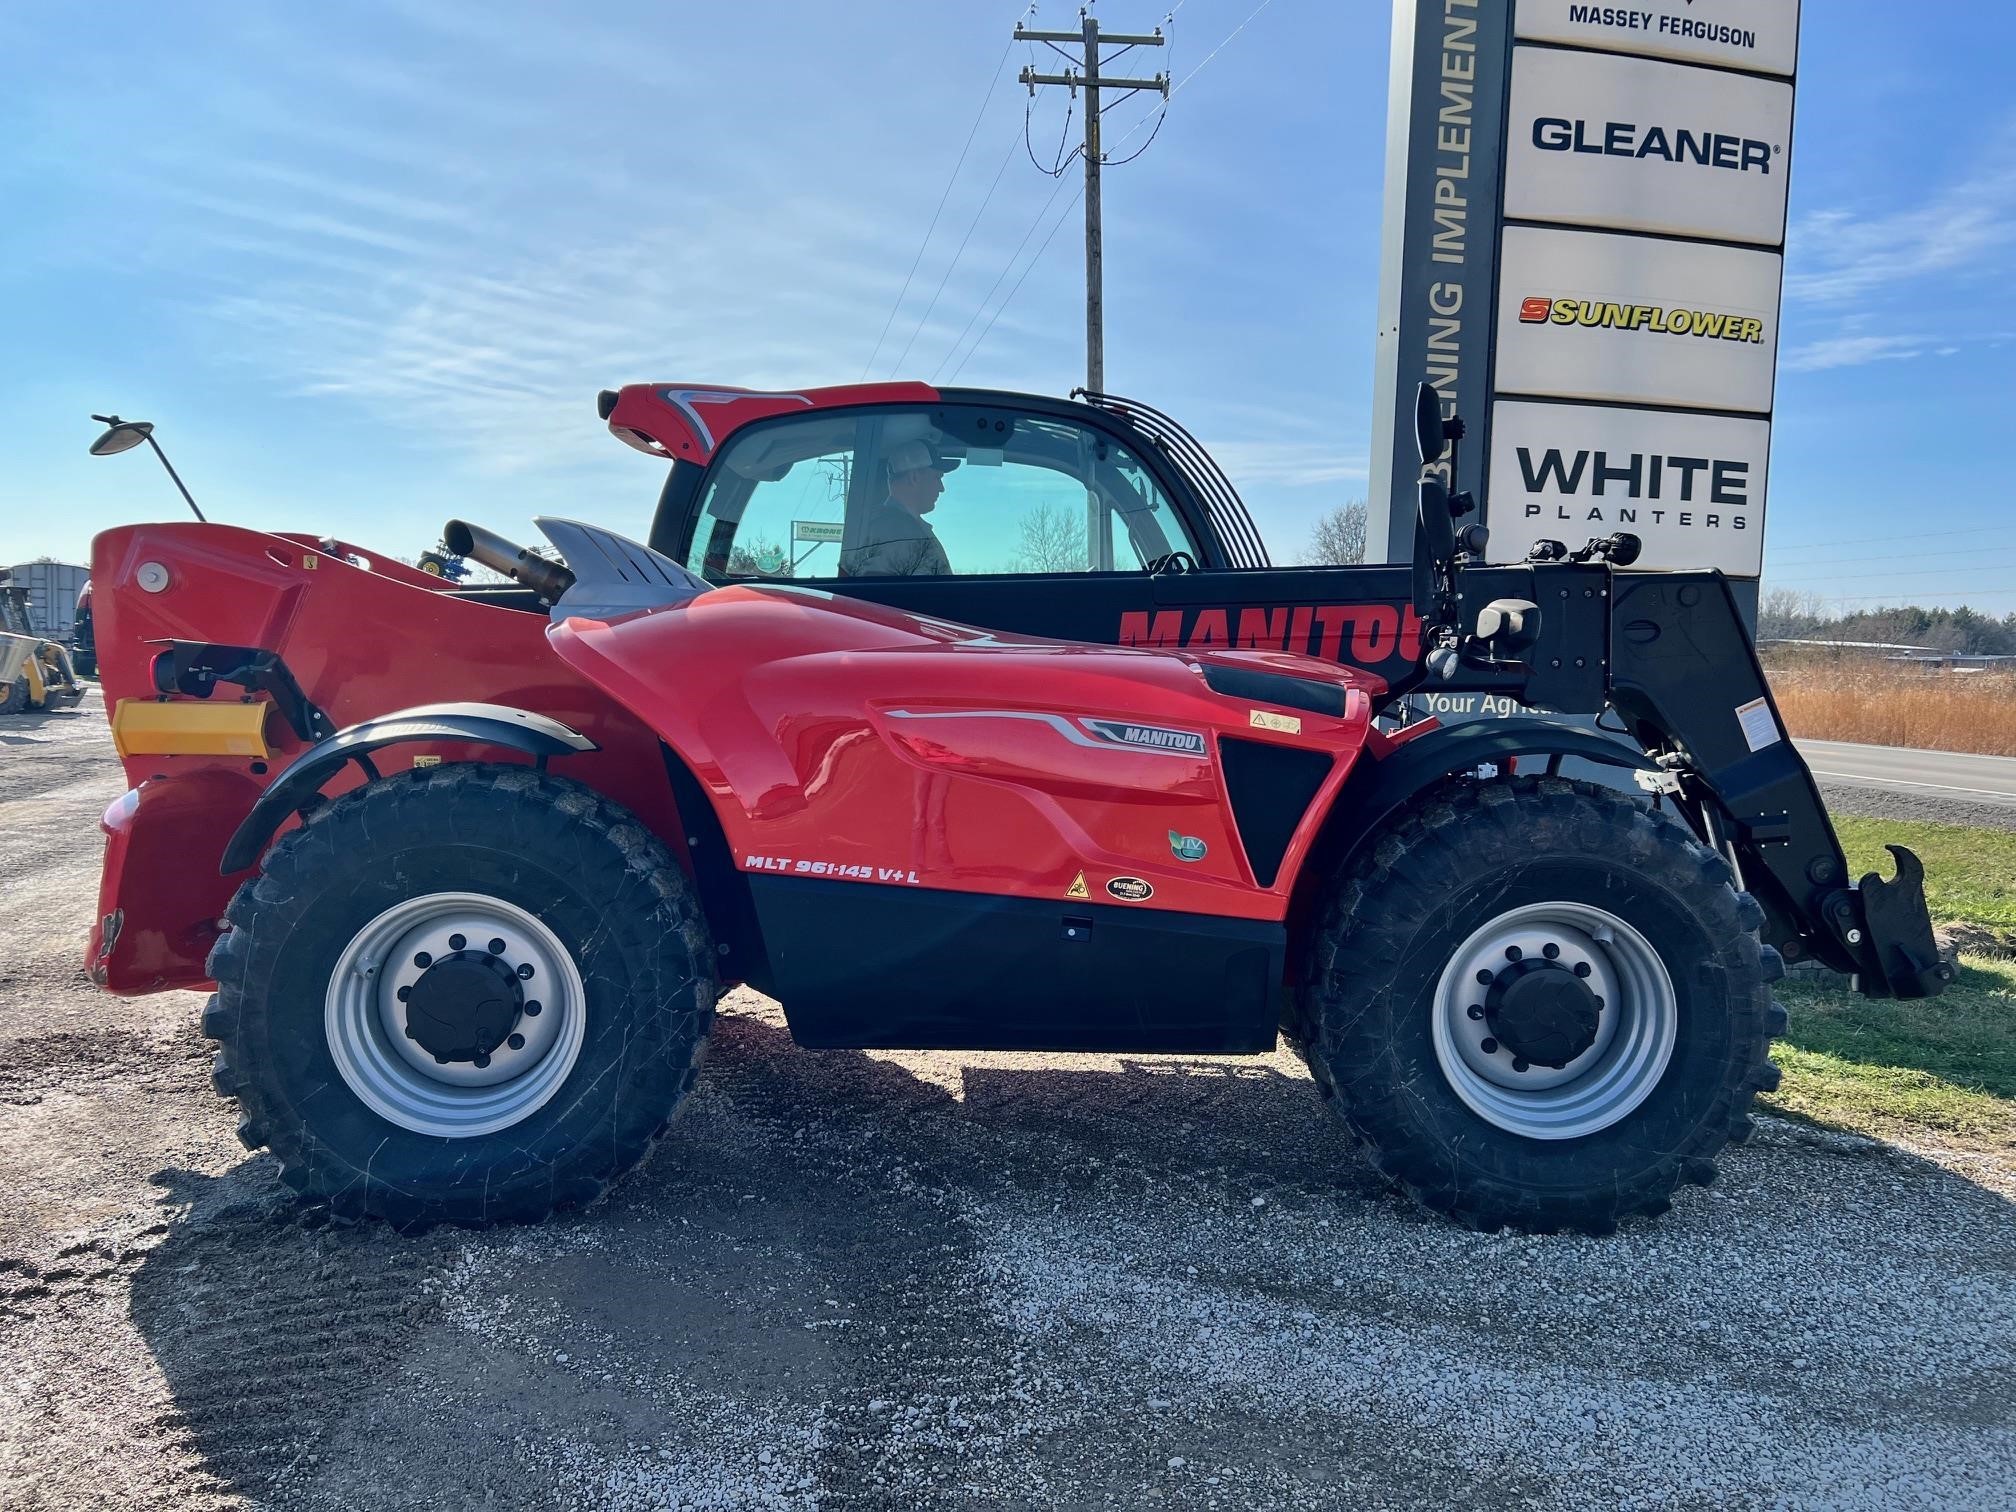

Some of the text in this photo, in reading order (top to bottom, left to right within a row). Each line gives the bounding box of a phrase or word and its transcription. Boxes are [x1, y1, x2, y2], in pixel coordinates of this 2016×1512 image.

[1569, 4, 1756, 48] MASSEY FERGUSON
[1550, 299, 1762, 344] SUNFLOWER
[1516, 447, 1749, 506] WHITE
[1524, 504, 1747, 530] PLANTERS
[1425, 692, 1475, 713] Your
[1124, 727, 1197, 750] MANITOU
[745, 855, 791, 871] MLT
[878, 868, 904, 882] V+
[907, 871, 920, 884] L
[1113, 881, 1144, 892] BUENING
